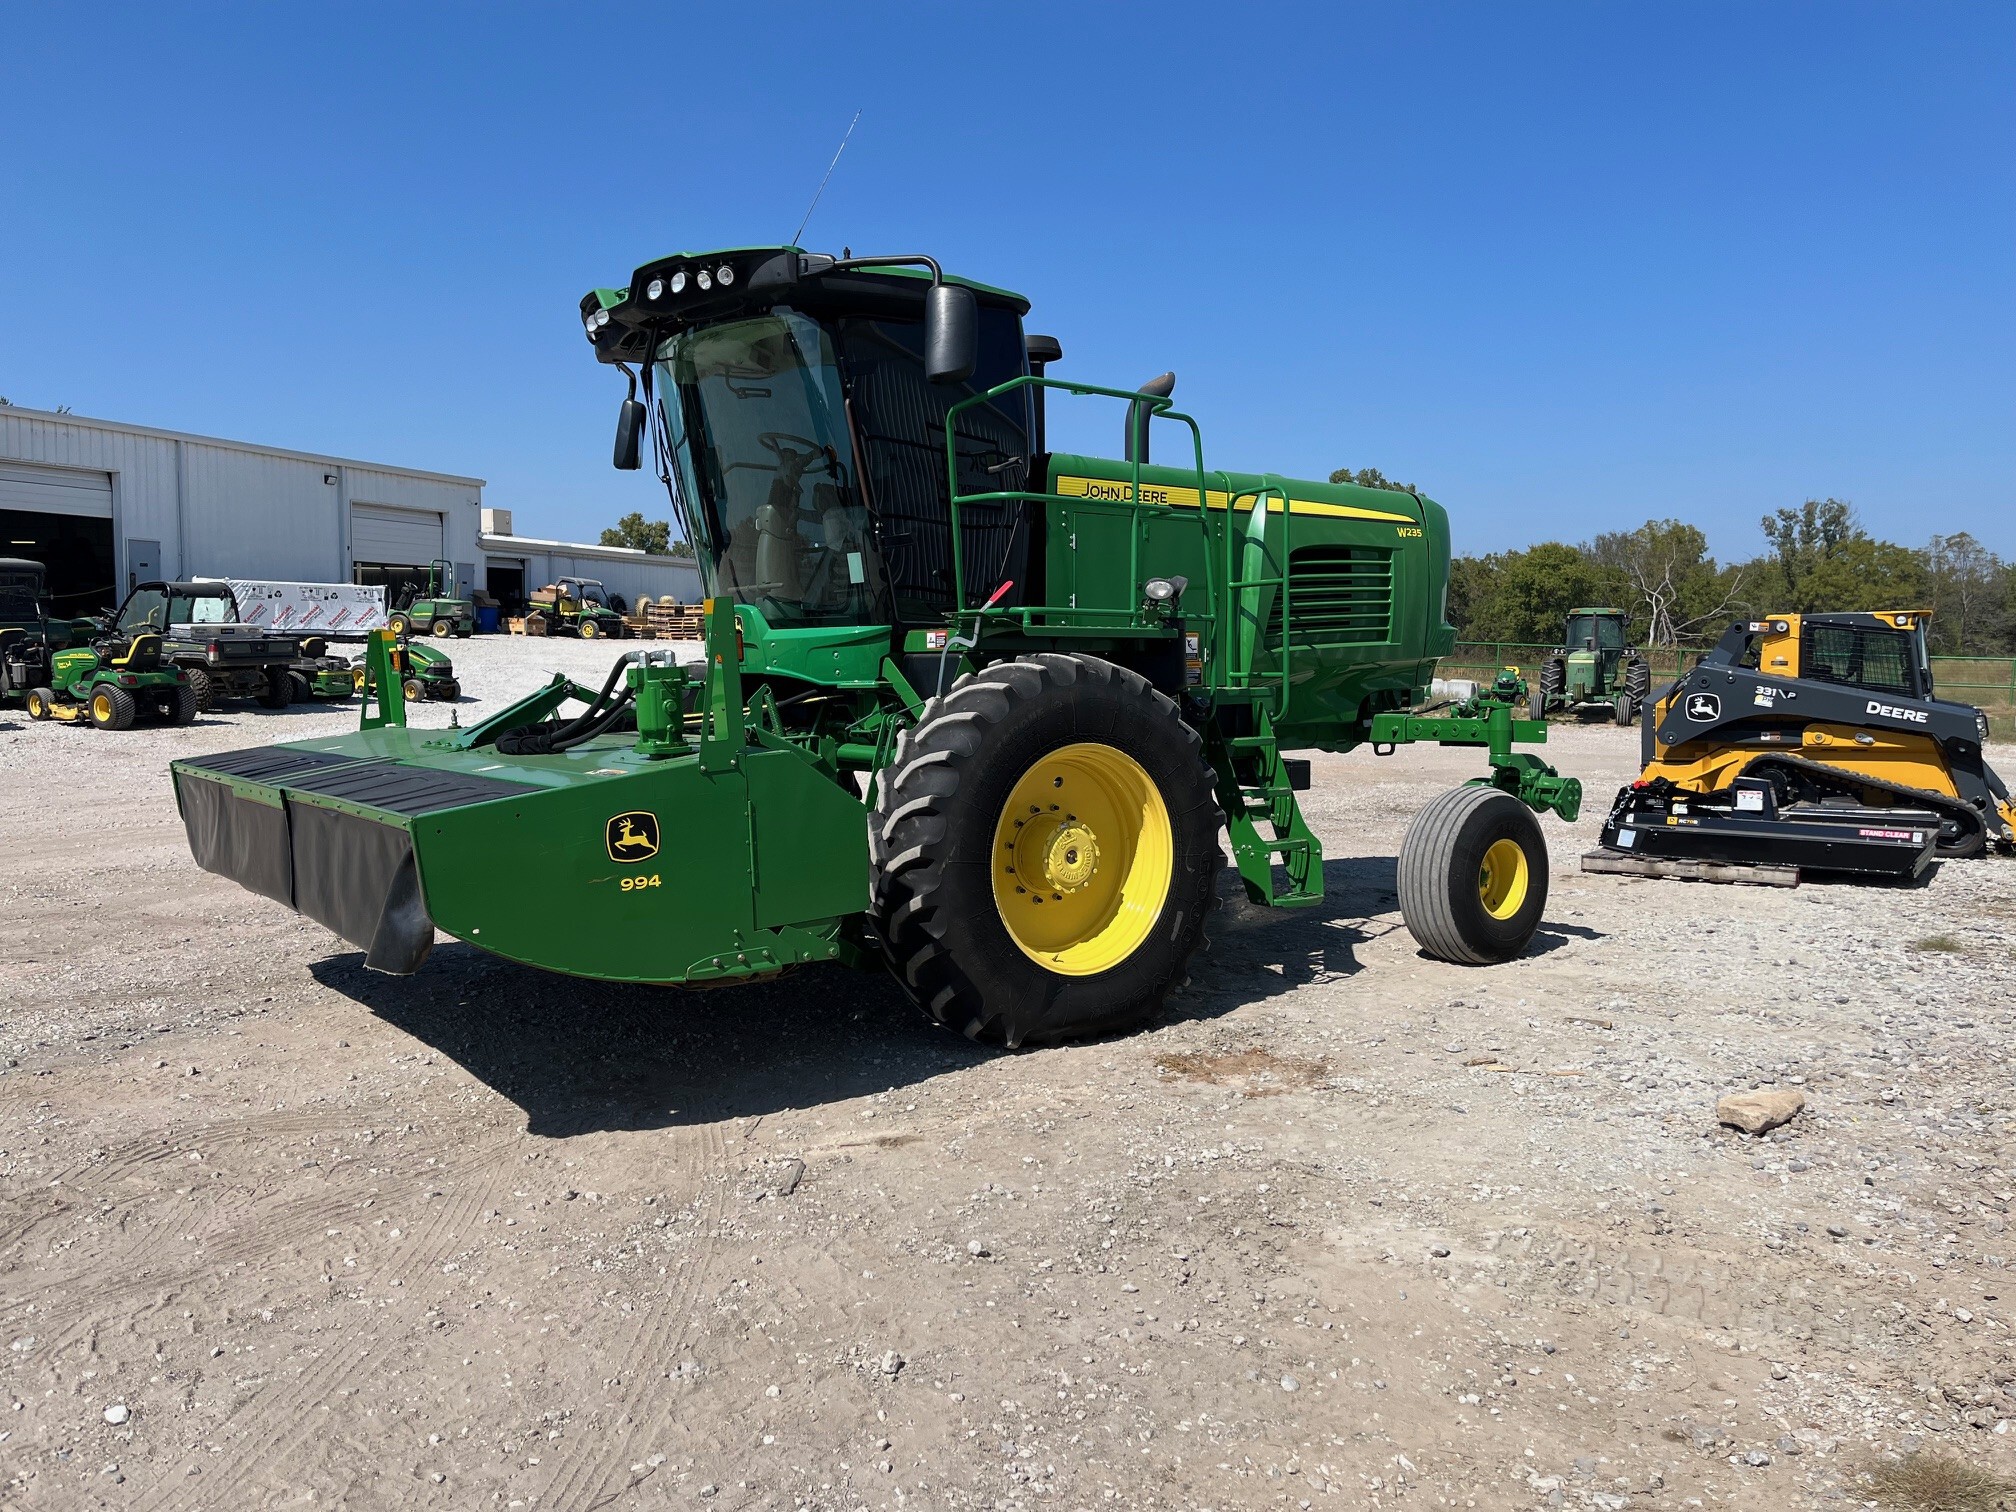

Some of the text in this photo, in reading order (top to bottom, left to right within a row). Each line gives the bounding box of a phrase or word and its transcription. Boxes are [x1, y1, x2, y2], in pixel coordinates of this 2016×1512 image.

[1081, 482, 1120, 500] JOHN
[1396, 526, 1423, 538] W235
[1755, 686, 1777, 697] 331
[1866, 700, 1929, 724] DEERE
[1860, 829, 1910, 839] STAND CLEAR
[620, 873, 662, 892] 994
